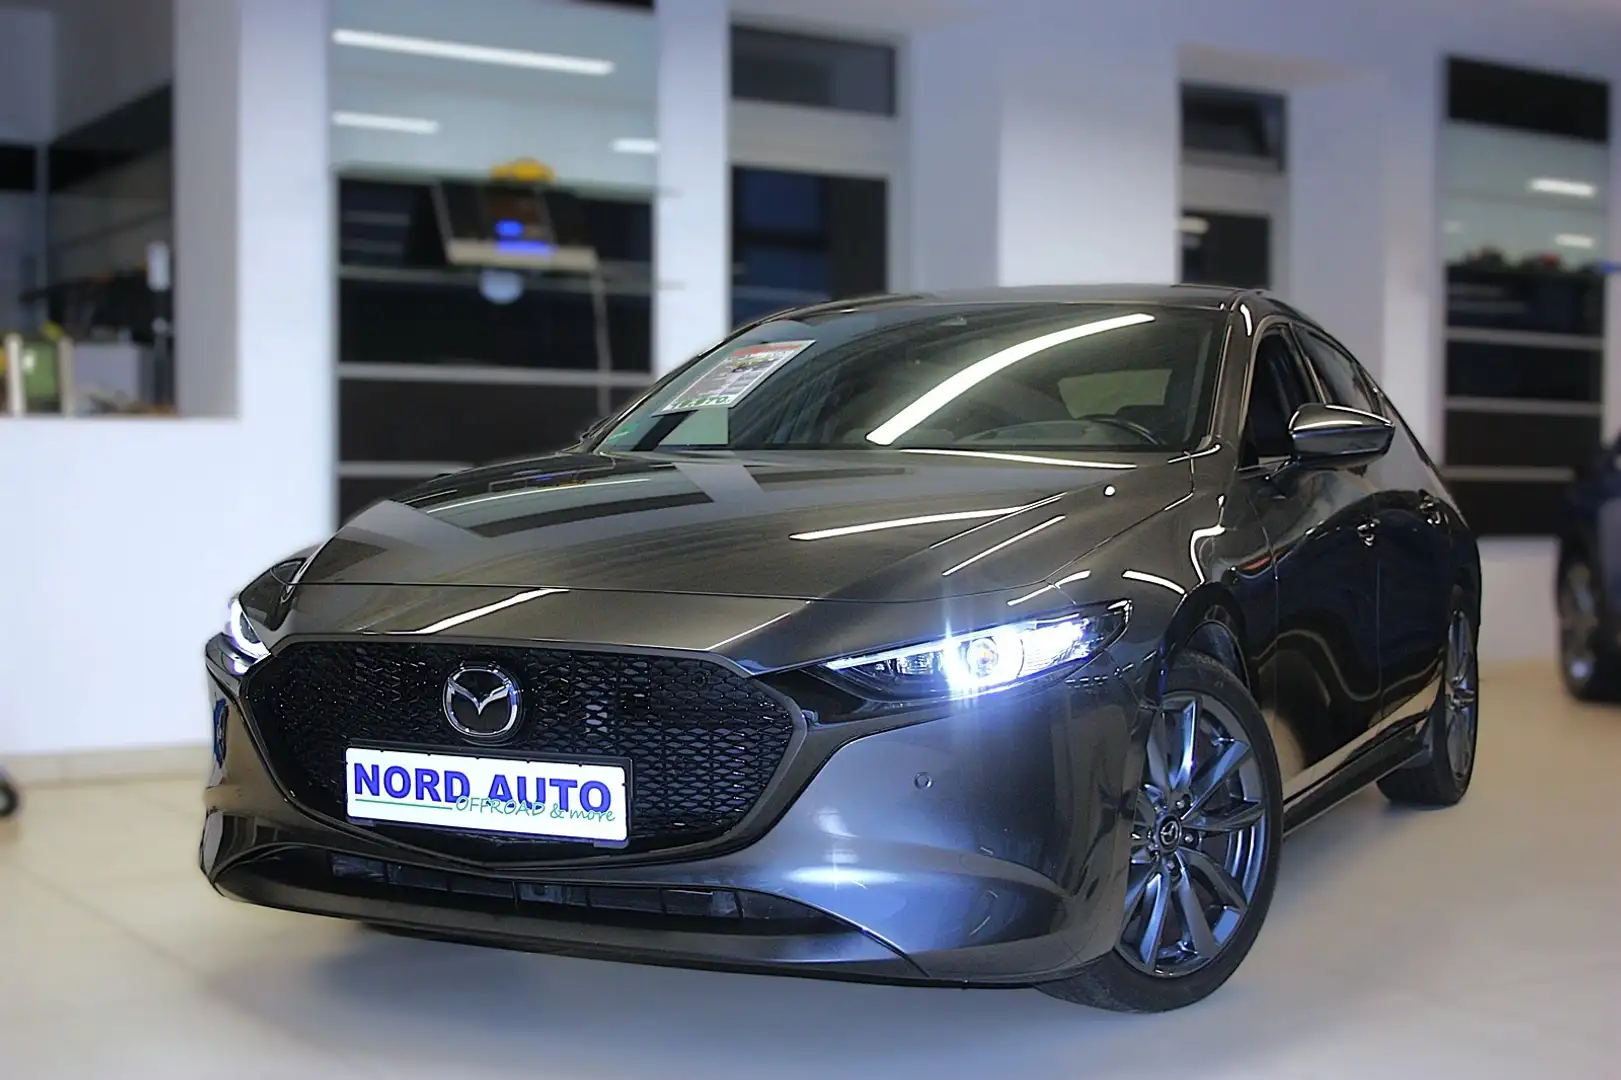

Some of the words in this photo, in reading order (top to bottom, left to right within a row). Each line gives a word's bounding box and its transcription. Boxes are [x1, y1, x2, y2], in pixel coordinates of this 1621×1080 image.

[354, 763, 470, 803] NORD
[488, 774, 611, 813] AUTO
[456, 795, 546, 818] OFFROAD
[550, 806, 565, 820] &
[570, 810, 616, 823] more
